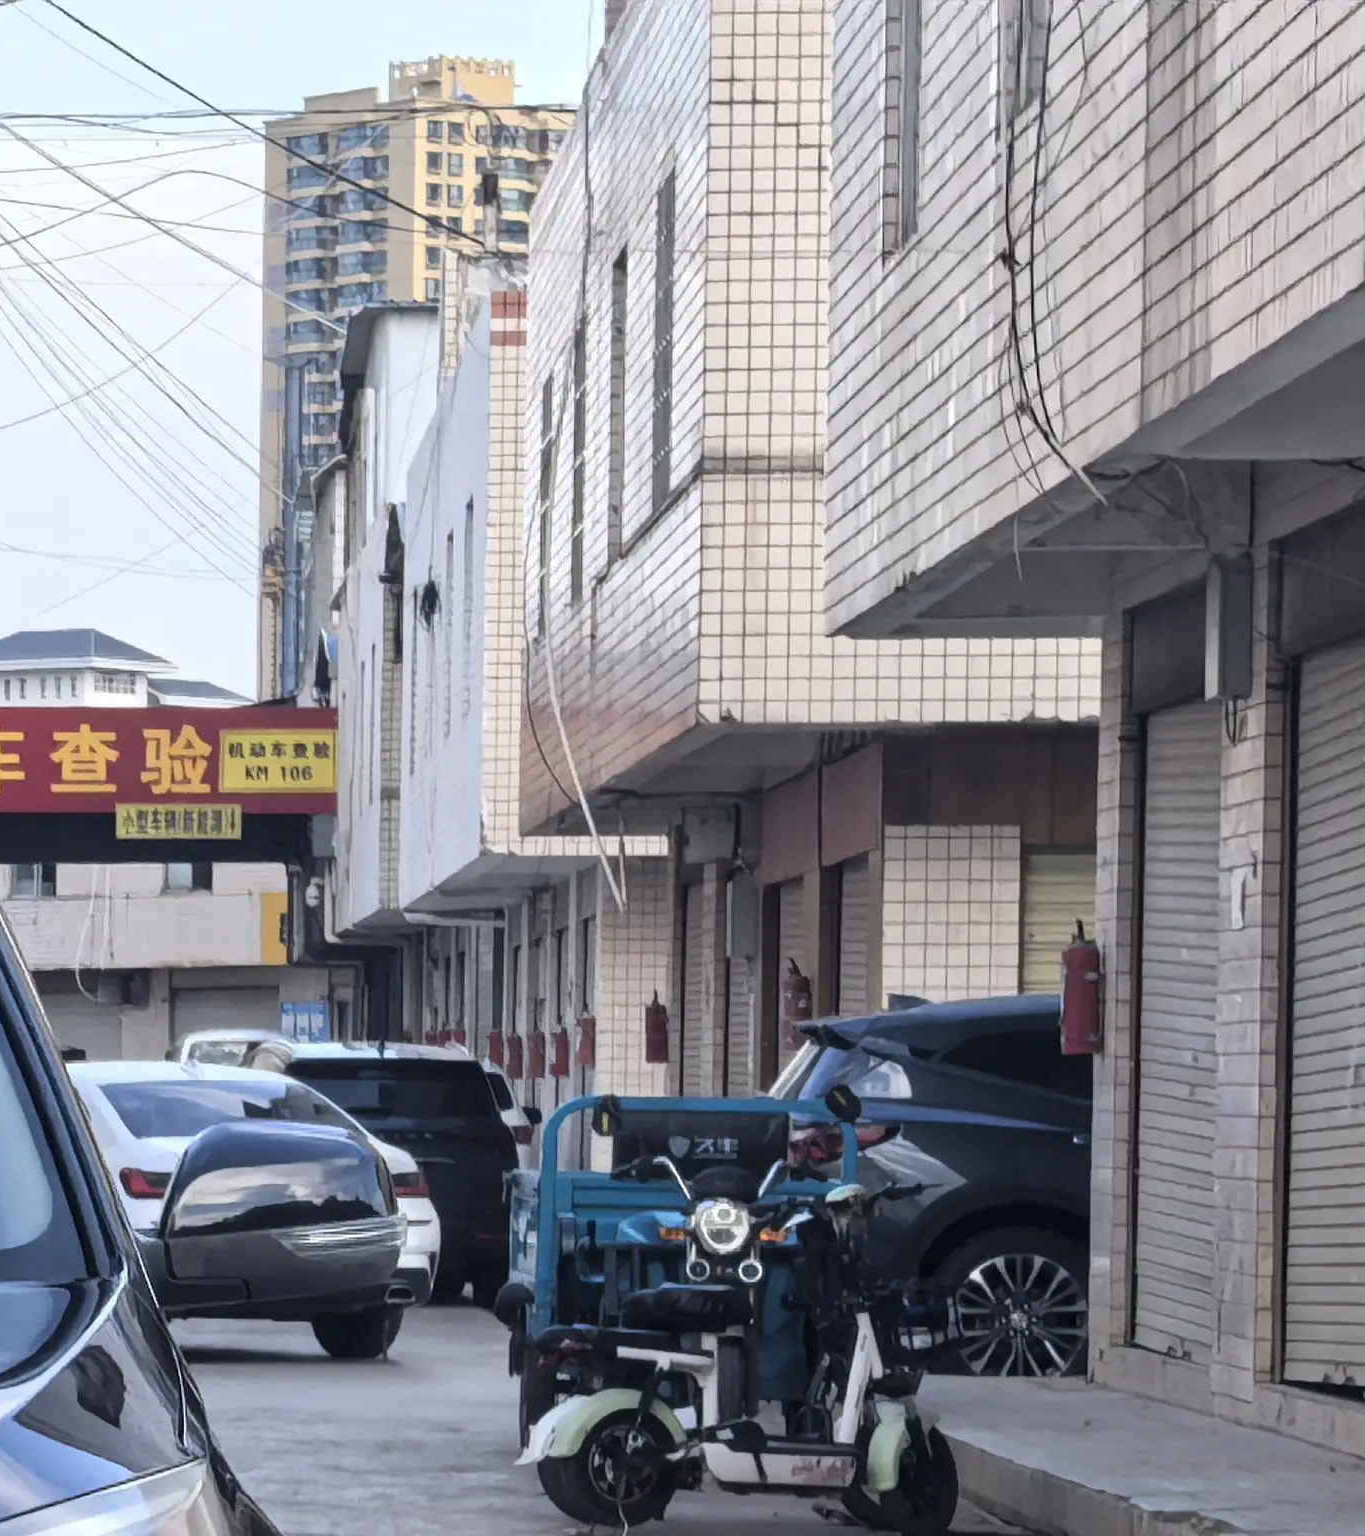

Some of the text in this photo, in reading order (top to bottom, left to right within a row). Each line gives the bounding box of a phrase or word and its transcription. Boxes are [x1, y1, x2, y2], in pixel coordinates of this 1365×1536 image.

[229, 741, 331, 760] 机动车查验
[245, 764, 269, 781] KM
